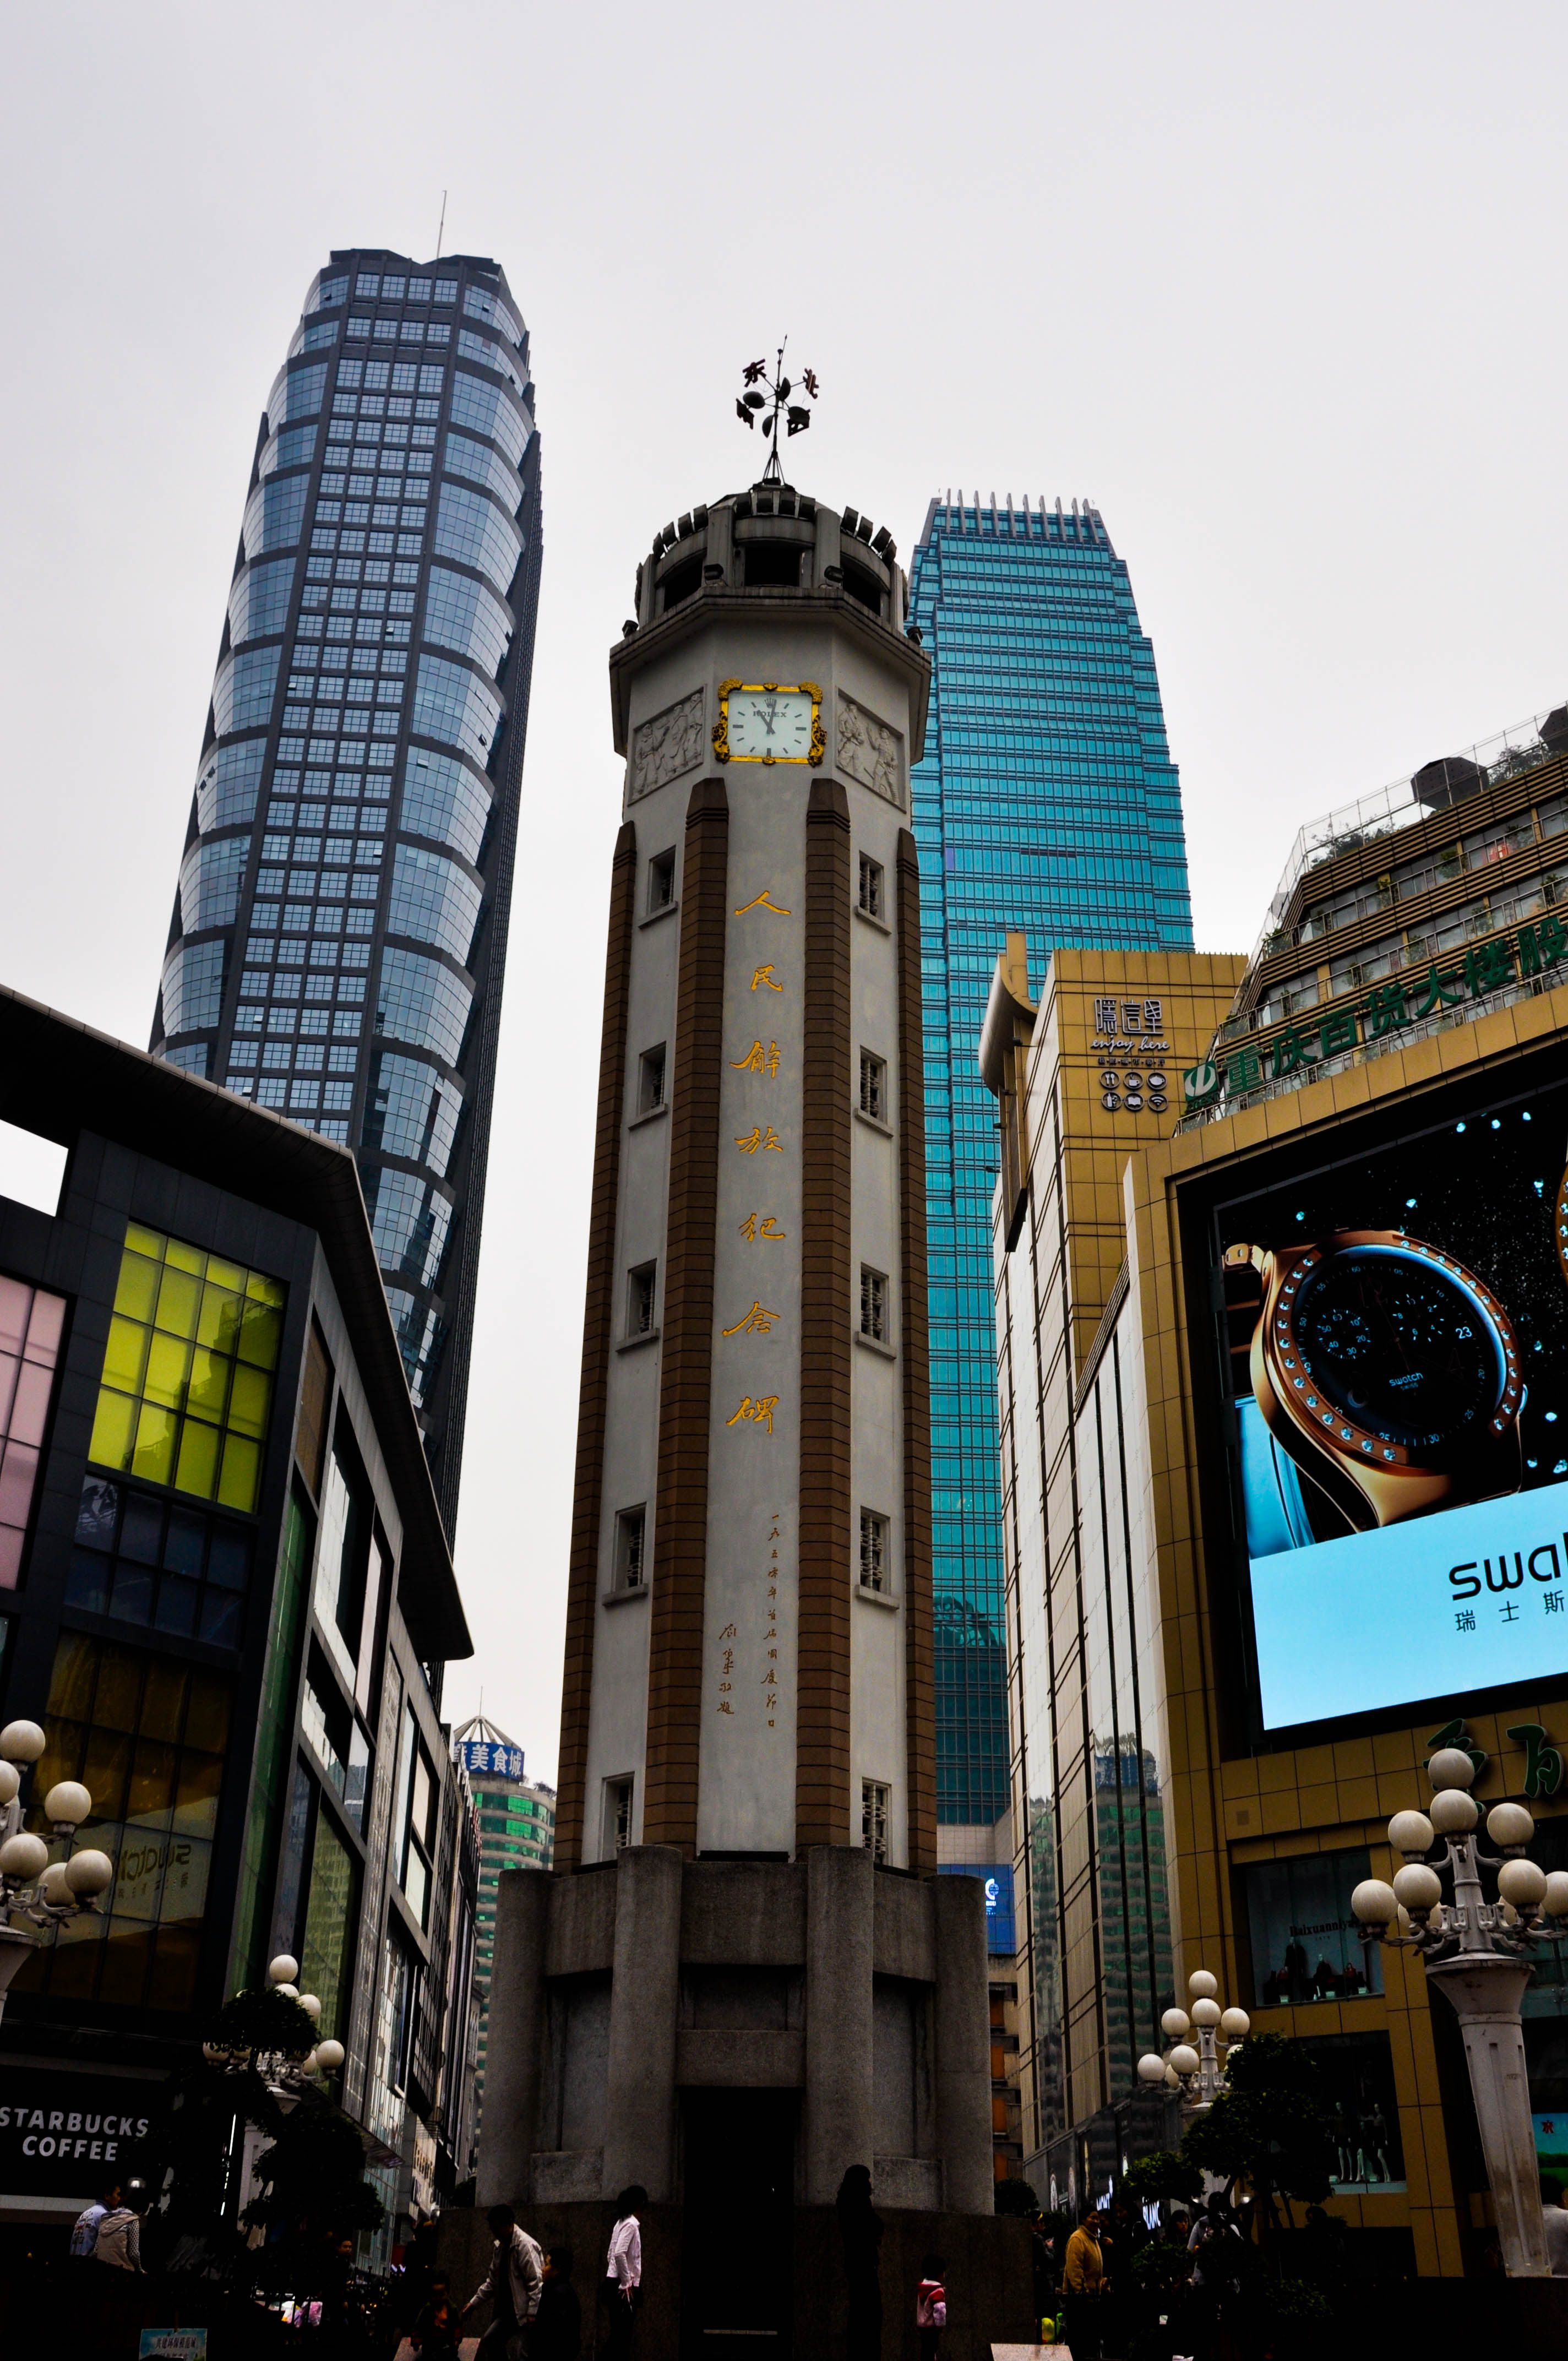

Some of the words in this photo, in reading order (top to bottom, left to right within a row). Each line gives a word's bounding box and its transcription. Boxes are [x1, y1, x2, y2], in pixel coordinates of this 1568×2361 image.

[1091, 1035, 1135, 1054] enjoy
[1139, 1036, 1170, 1051] here
[1455, 1326, 1473, 1340] 23
[1388, 1372, 1424, 1387] swatch
[1455, 1590, 1565, 1633] 瑞士斯
[0, 2106, 149, 2137] STARBUCKS
[22, 2135, 119, 2162] COFFEE
